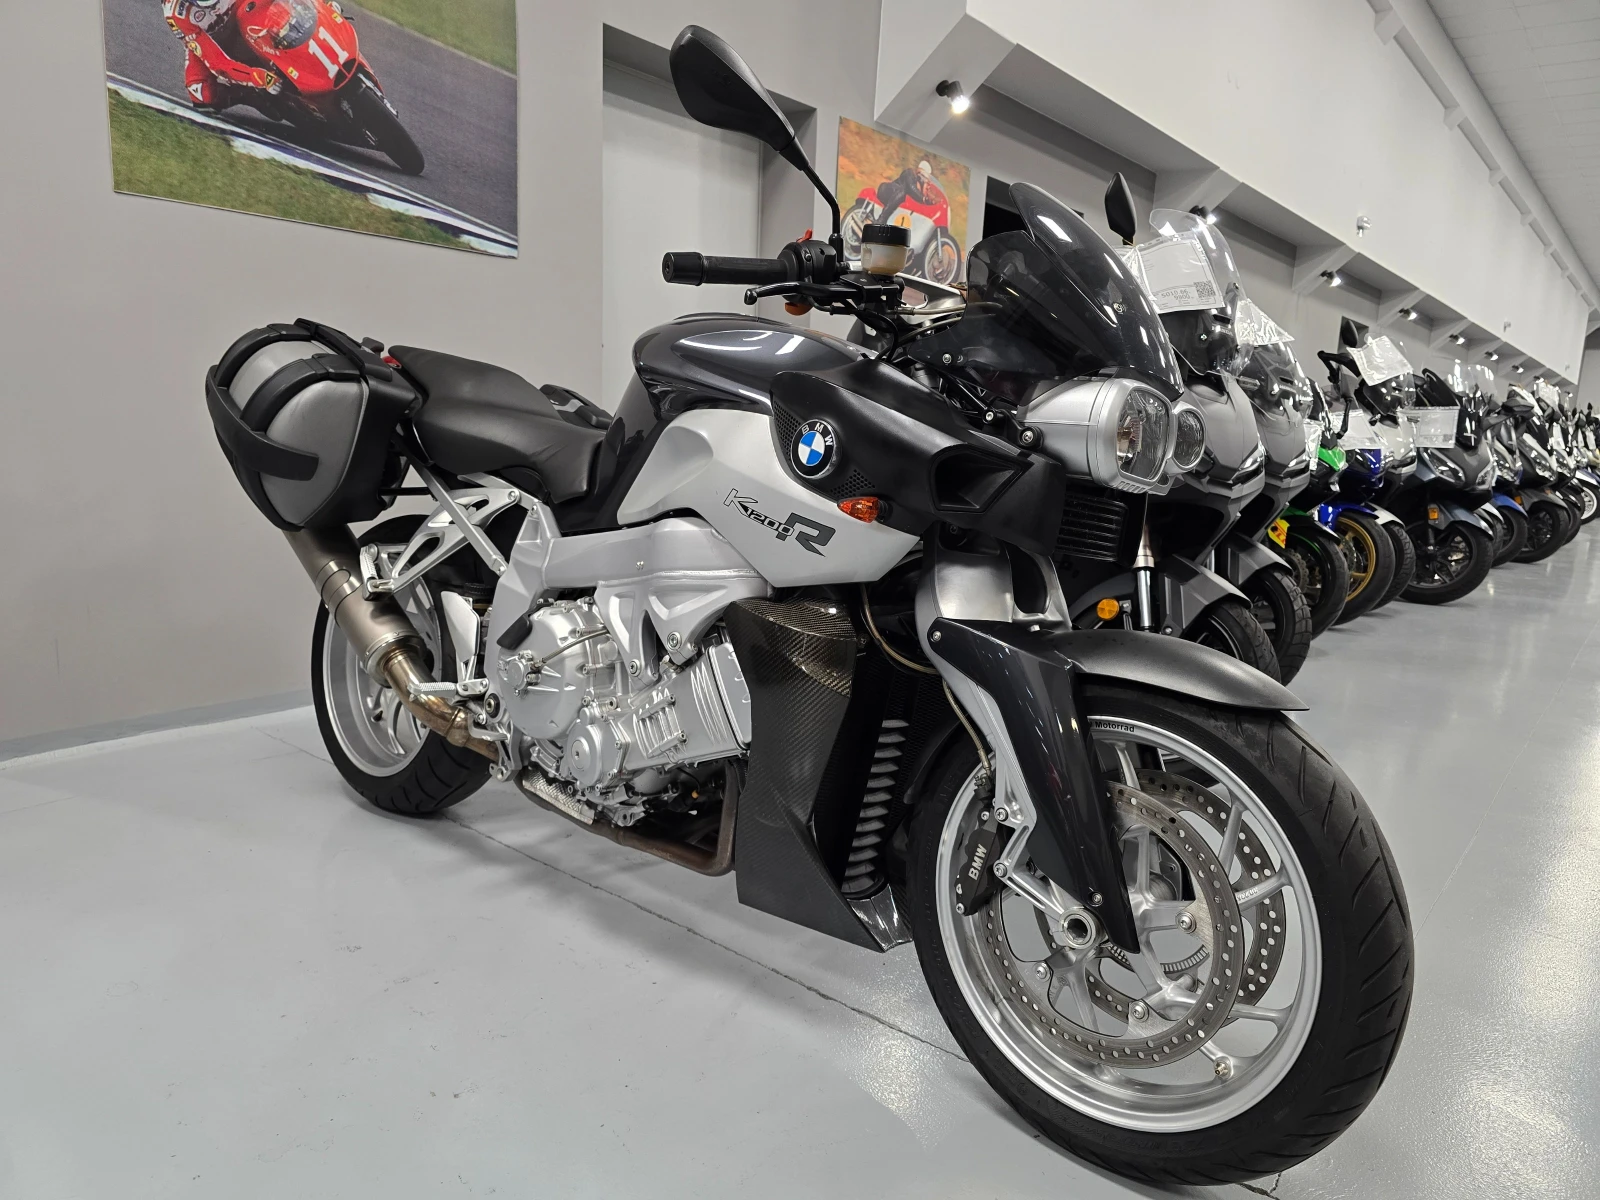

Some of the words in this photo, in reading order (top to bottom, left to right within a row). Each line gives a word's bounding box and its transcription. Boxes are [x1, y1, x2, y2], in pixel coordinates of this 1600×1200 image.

[307, 26, 350, 79] 11
[801, 422, 834, 446] BMW
[1095, 721, 1135, 733] Motorrad
[968, 843, 987, 881] BMW
